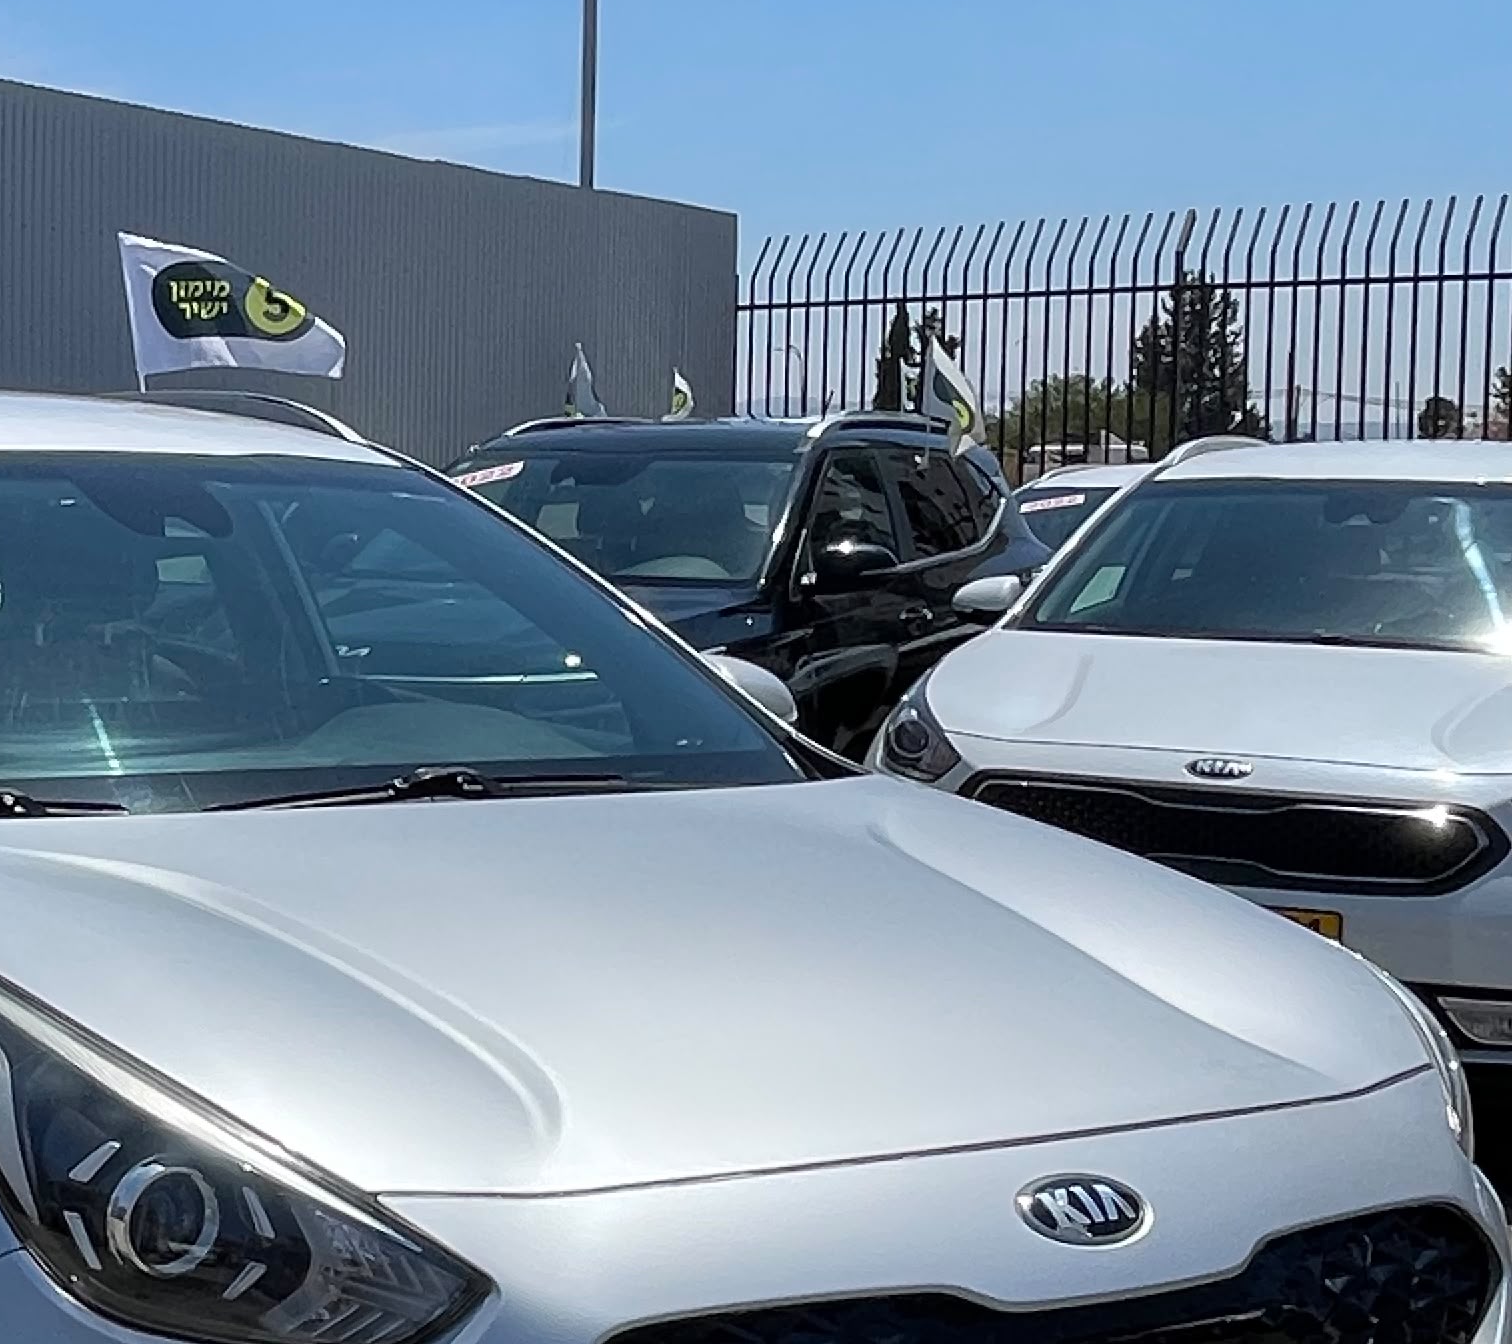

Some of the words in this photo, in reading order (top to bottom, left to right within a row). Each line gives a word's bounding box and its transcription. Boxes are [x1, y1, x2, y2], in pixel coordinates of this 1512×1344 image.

[169, 280, 230, 302] מימון
[178, 300, 228, 320] ישיר
[1035, 1183, 1136, 1228] KIA
